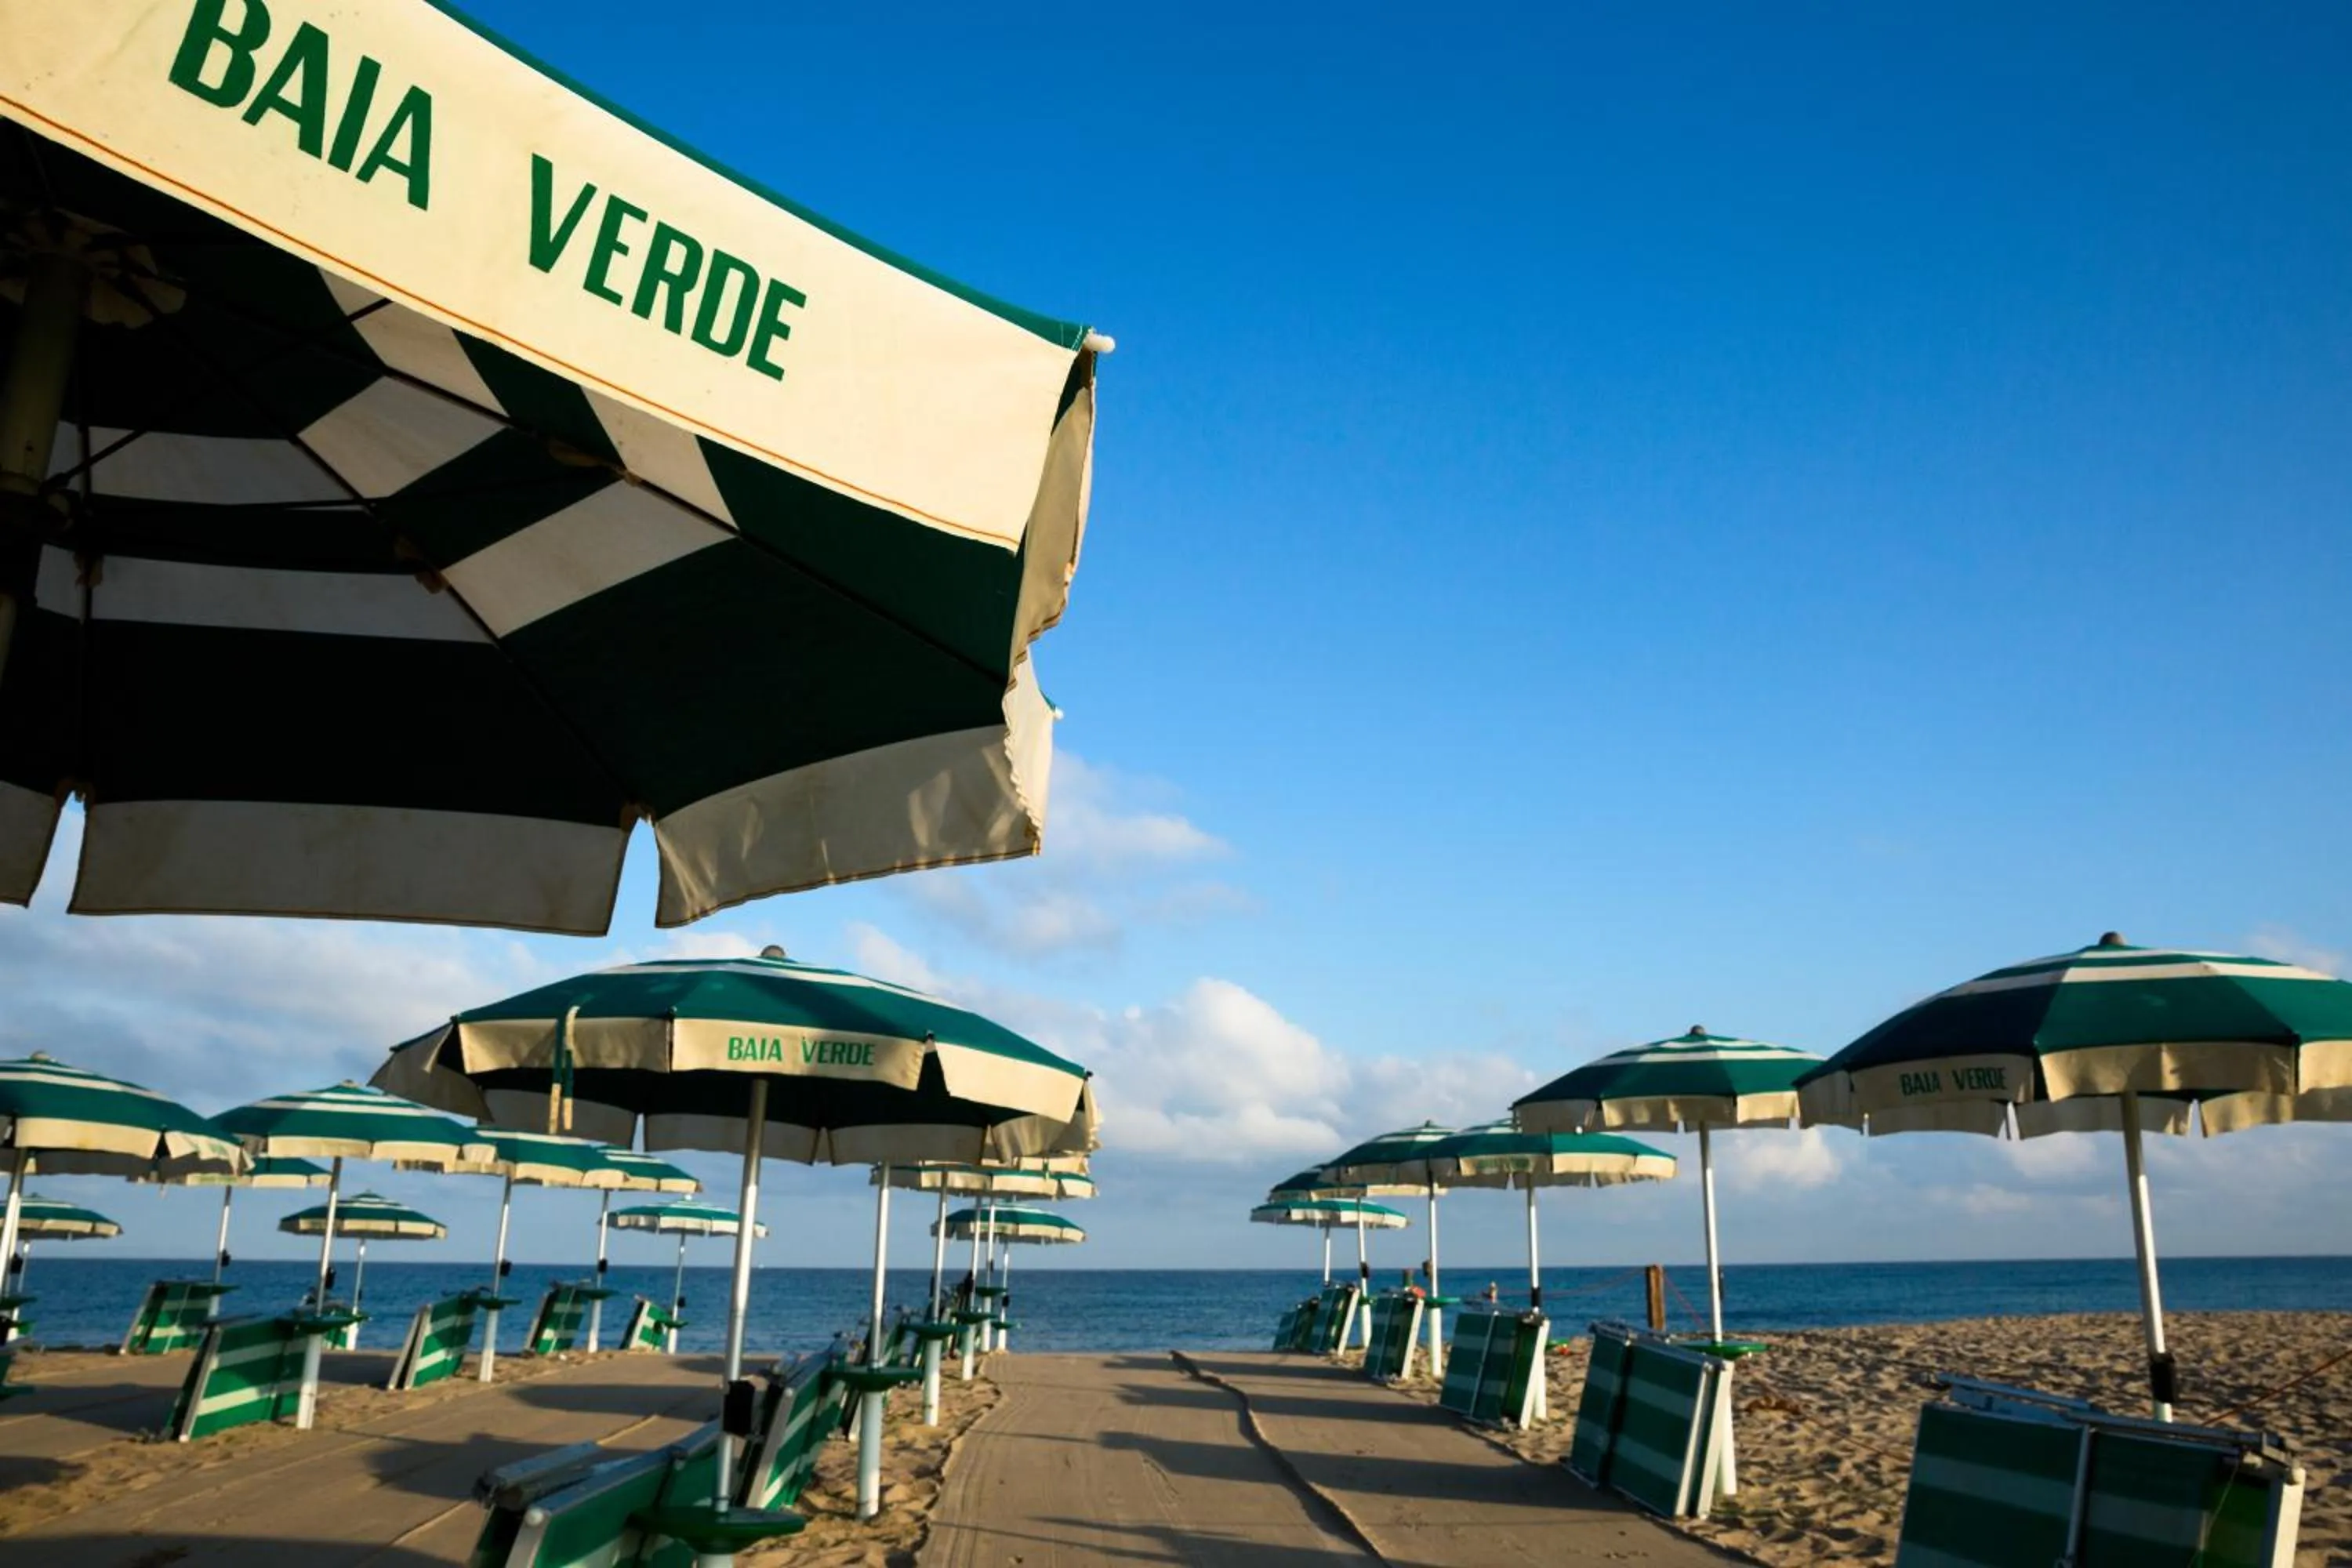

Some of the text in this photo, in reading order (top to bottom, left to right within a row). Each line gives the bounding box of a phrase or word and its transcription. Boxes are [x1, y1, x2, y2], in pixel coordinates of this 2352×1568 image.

[169, 0, 808, 382] BAIA VERDE
[728, 1036, 876, 1066] BAIA VERDE
[1900, 1066, 2008, 1096] BAIA VERDE
